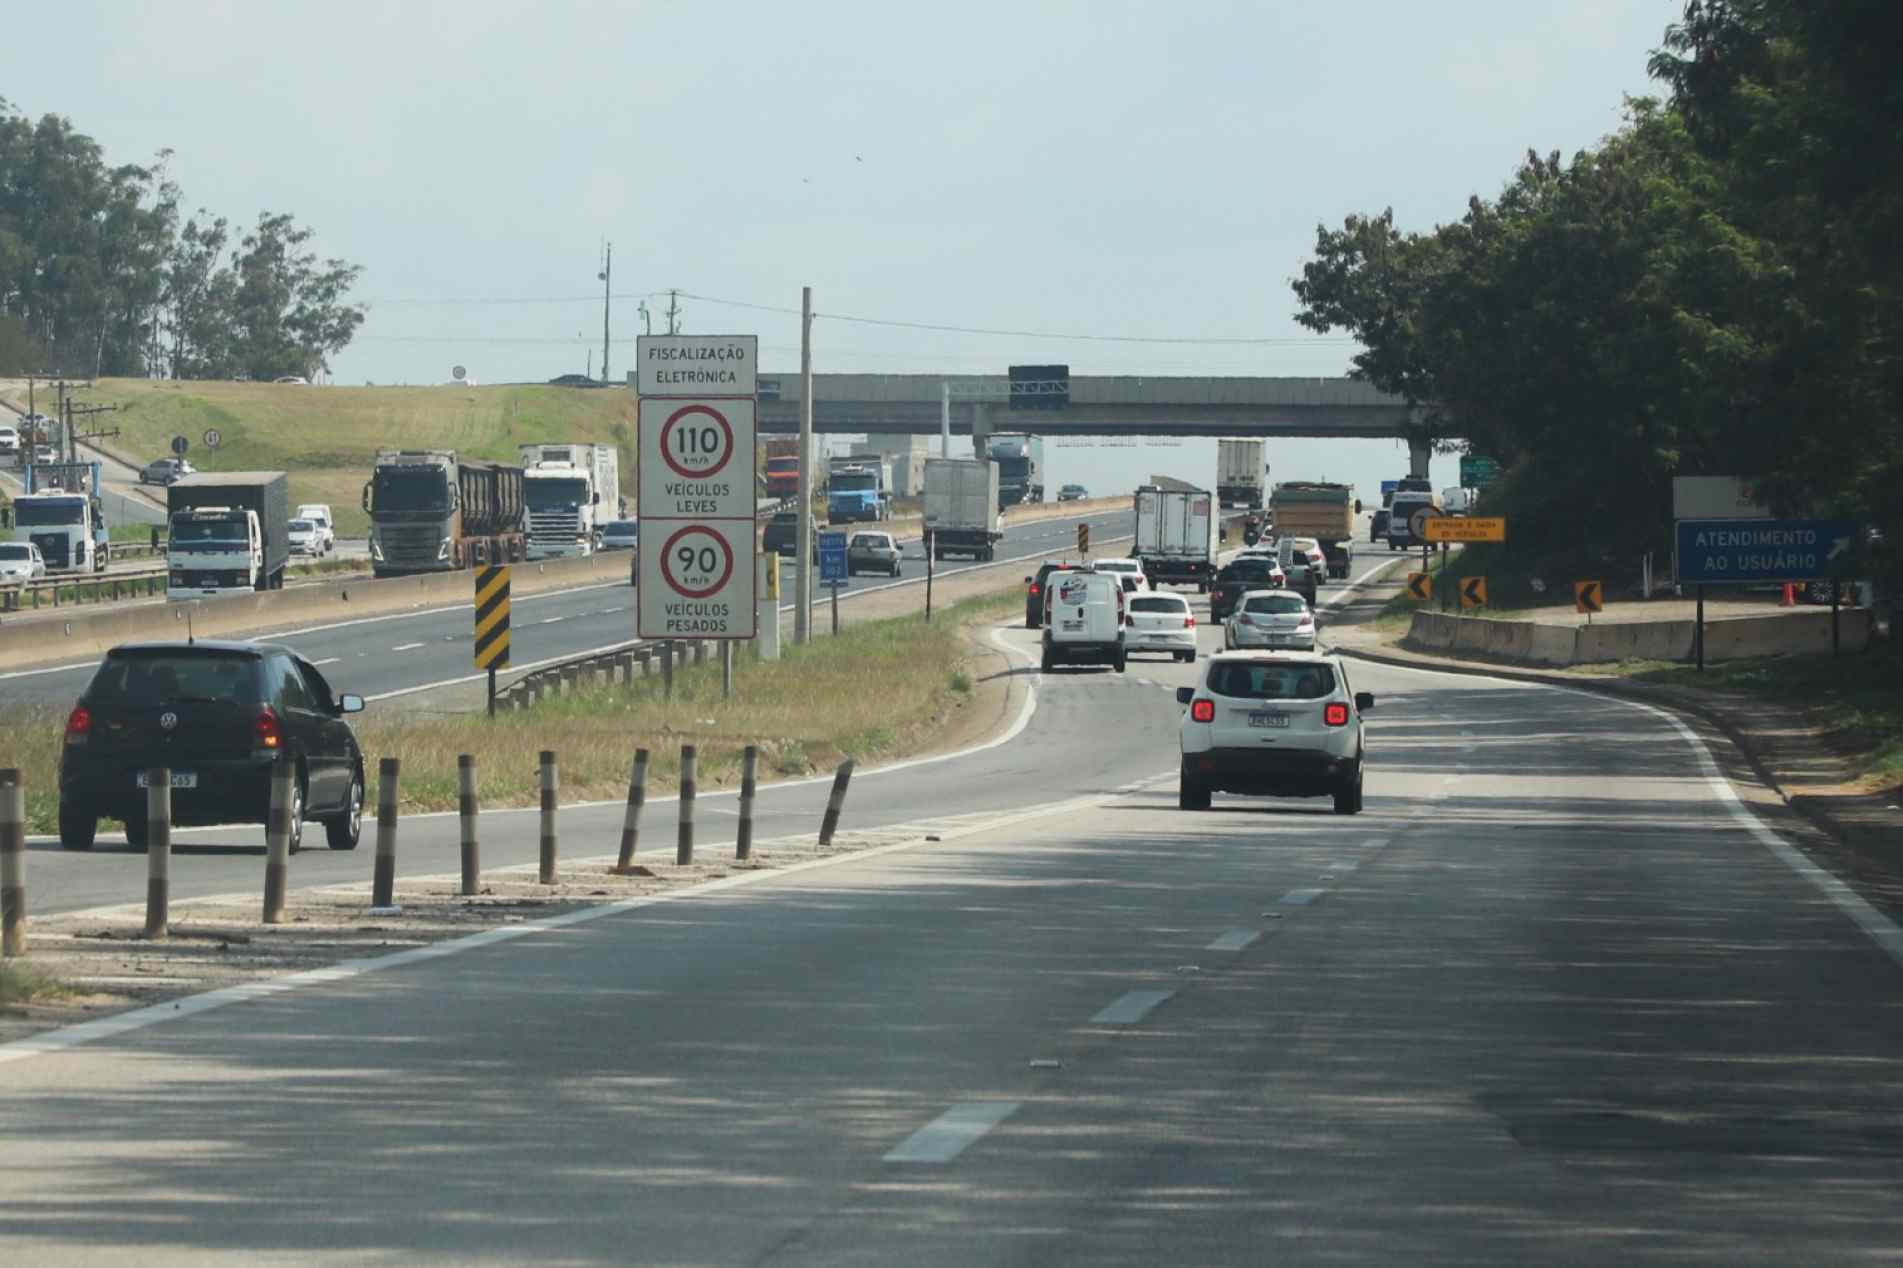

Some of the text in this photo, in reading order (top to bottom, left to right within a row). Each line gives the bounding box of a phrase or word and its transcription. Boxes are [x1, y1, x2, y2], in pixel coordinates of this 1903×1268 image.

[649, 343, 744, 363] FISCALIZAÇÃO
[656, 365, 736, 383] ELETRÔNICA
[678, 427, 718, 453] 110
[677, 500, 717, 512] LEVES
[1695, 530, 1817, 546] ATENDIMENTO
[678, 547, 716, 573] 90
[1704, 551, 1816, 570] AO USUÁRIO
[667, 620, 727, 632] PESADOS
